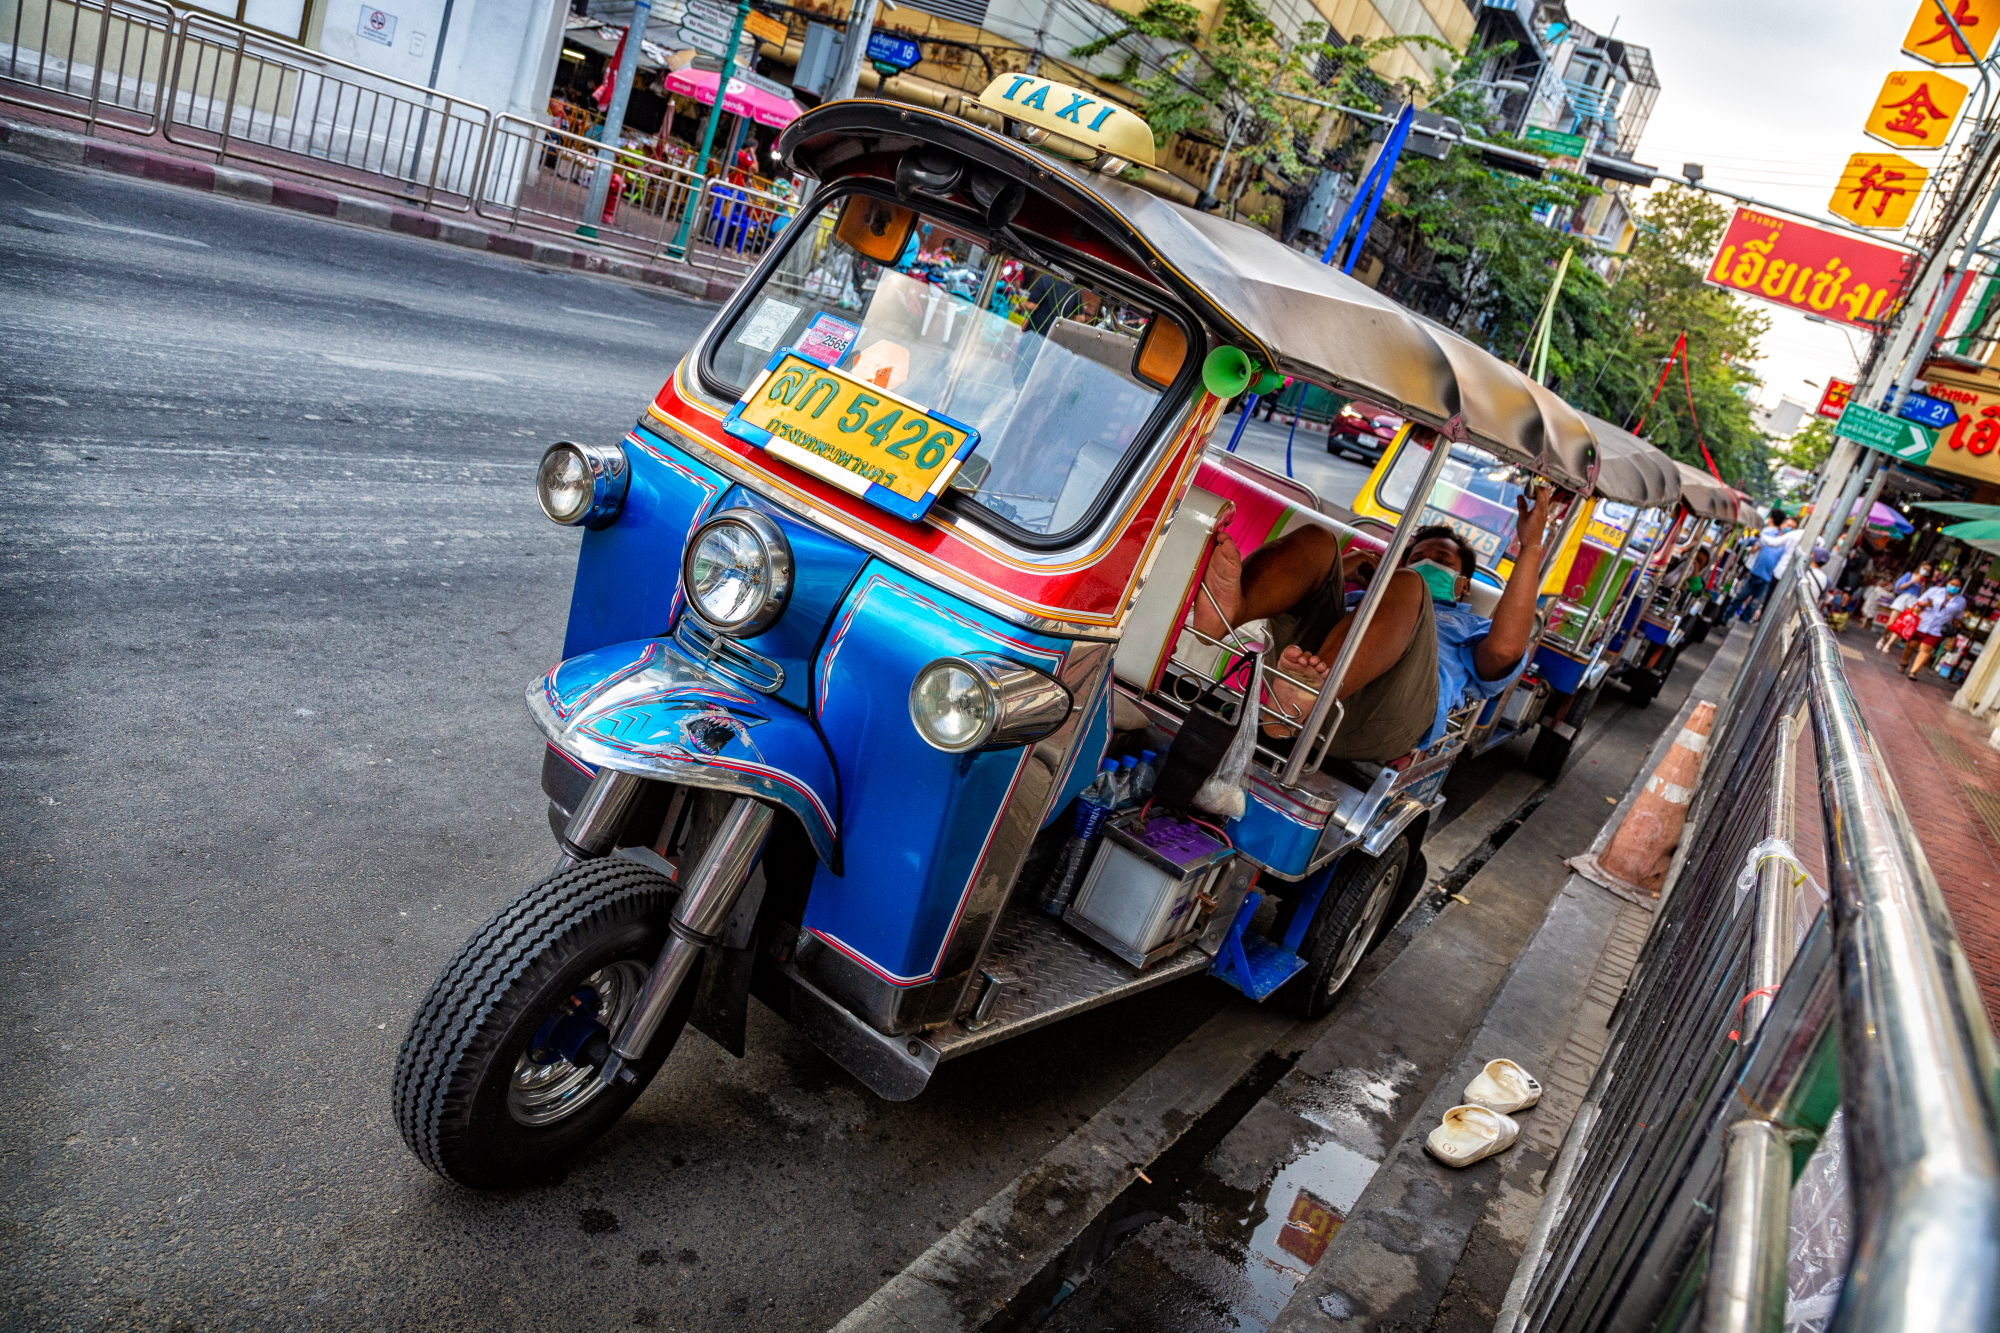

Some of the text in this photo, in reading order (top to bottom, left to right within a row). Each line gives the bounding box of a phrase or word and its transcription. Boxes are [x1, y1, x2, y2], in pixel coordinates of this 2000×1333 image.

[902, 44, 915, 60] 16
[1916, 0, 1979, 55] 大
[1002, 75, 1117, 132] TAXI
[1881, 82, 1950, 139] 金
[1848, 163, 1906, 218] 行
[822, 334, 849, 352] 2565
[769, 366, 954, 470] สก 5426
[1929, 382, 1979, 407] ห้างทอง
[1931, 404, 1950, 421] 21
[766, 418, 898, 488] กรุงเทพมหานคร
[1453, 521, 1497, 552] 3175
